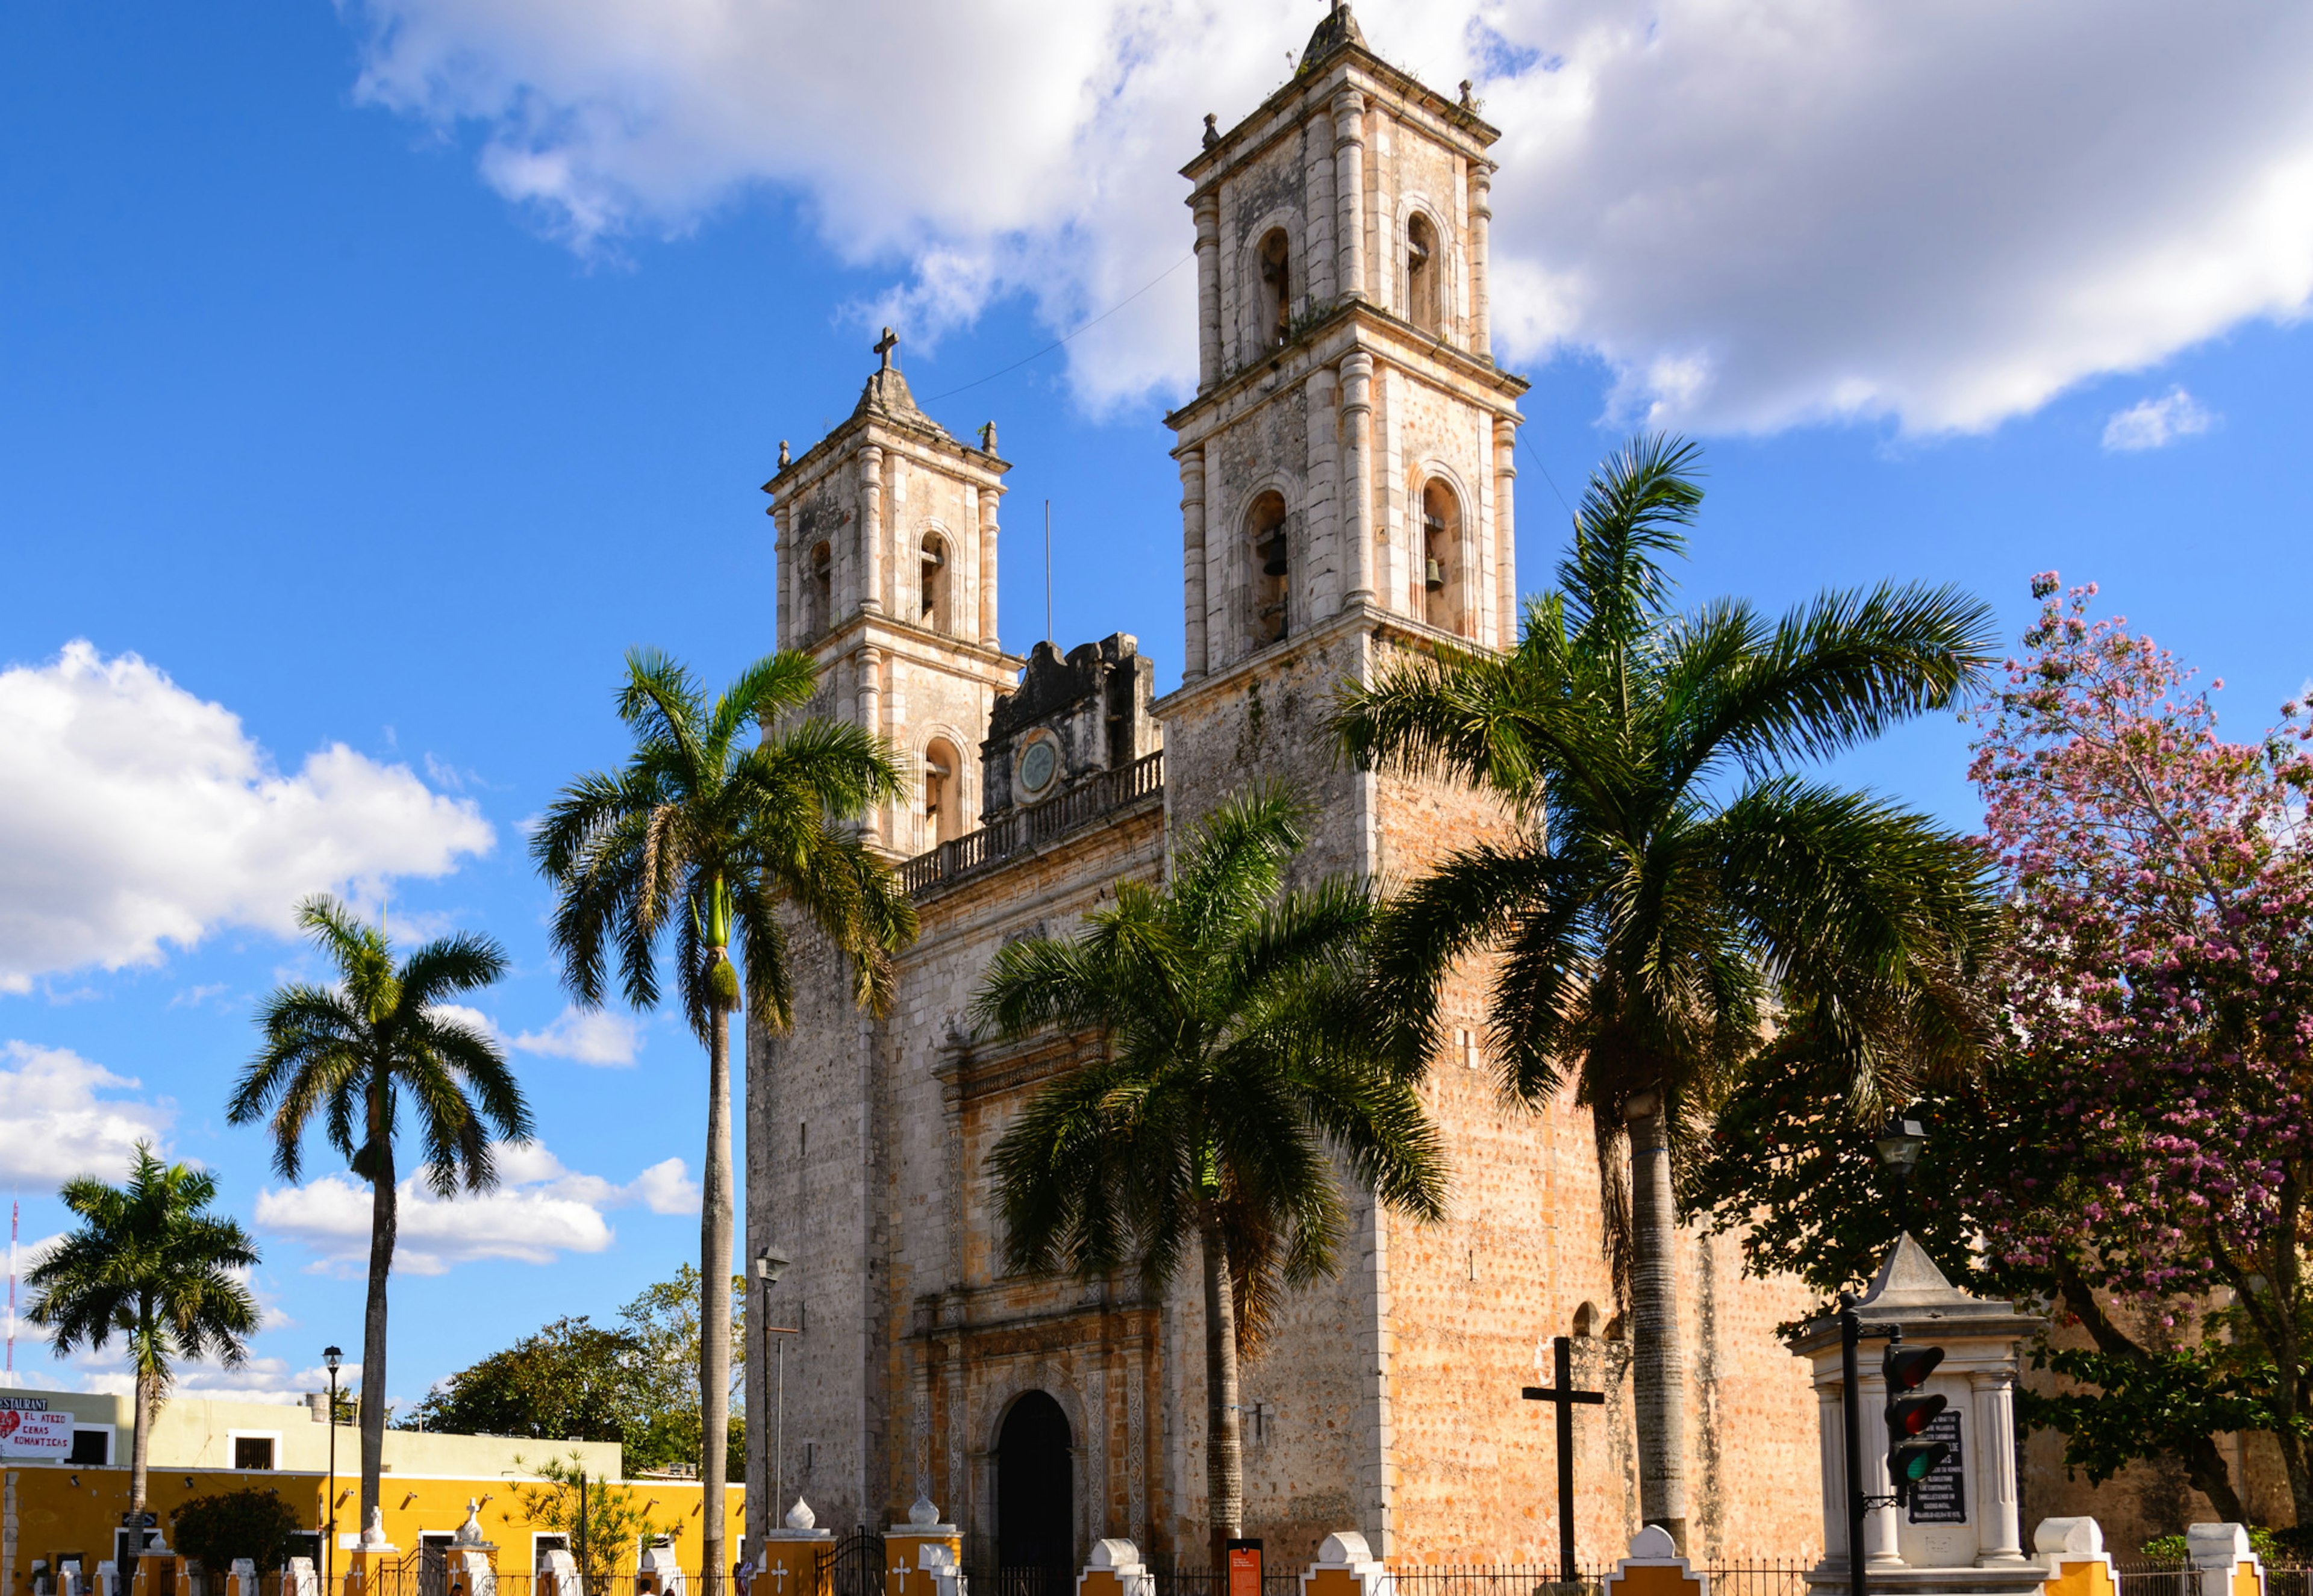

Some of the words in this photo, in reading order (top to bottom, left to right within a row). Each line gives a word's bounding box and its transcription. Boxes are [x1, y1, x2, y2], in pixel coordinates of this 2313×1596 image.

[41, 1414, 66, 1423] ATRIO
[23, 1426, 49, 1435] CENAS
[14, 1436, 67, 1447] ROMANTICAS
